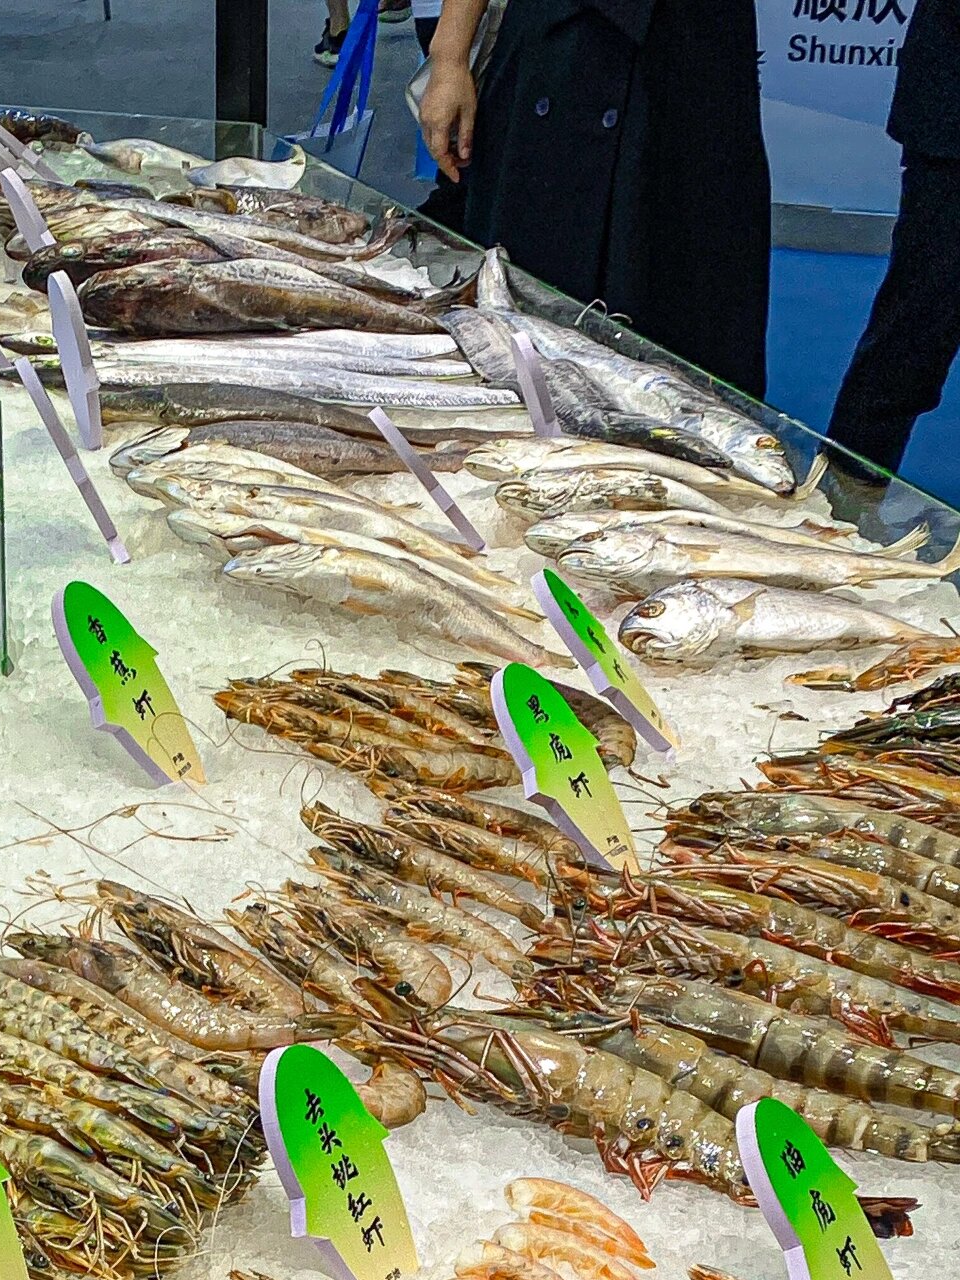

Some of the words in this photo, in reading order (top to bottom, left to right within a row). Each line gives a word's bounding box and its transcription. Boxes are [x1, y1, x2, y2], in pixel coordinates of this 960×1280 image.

[88, 614, 156, 720] 香蕉虾
[526, 694, 592, 798] 黑虎虾
[304, 1088, 385, 1252] 去头桃红虾
